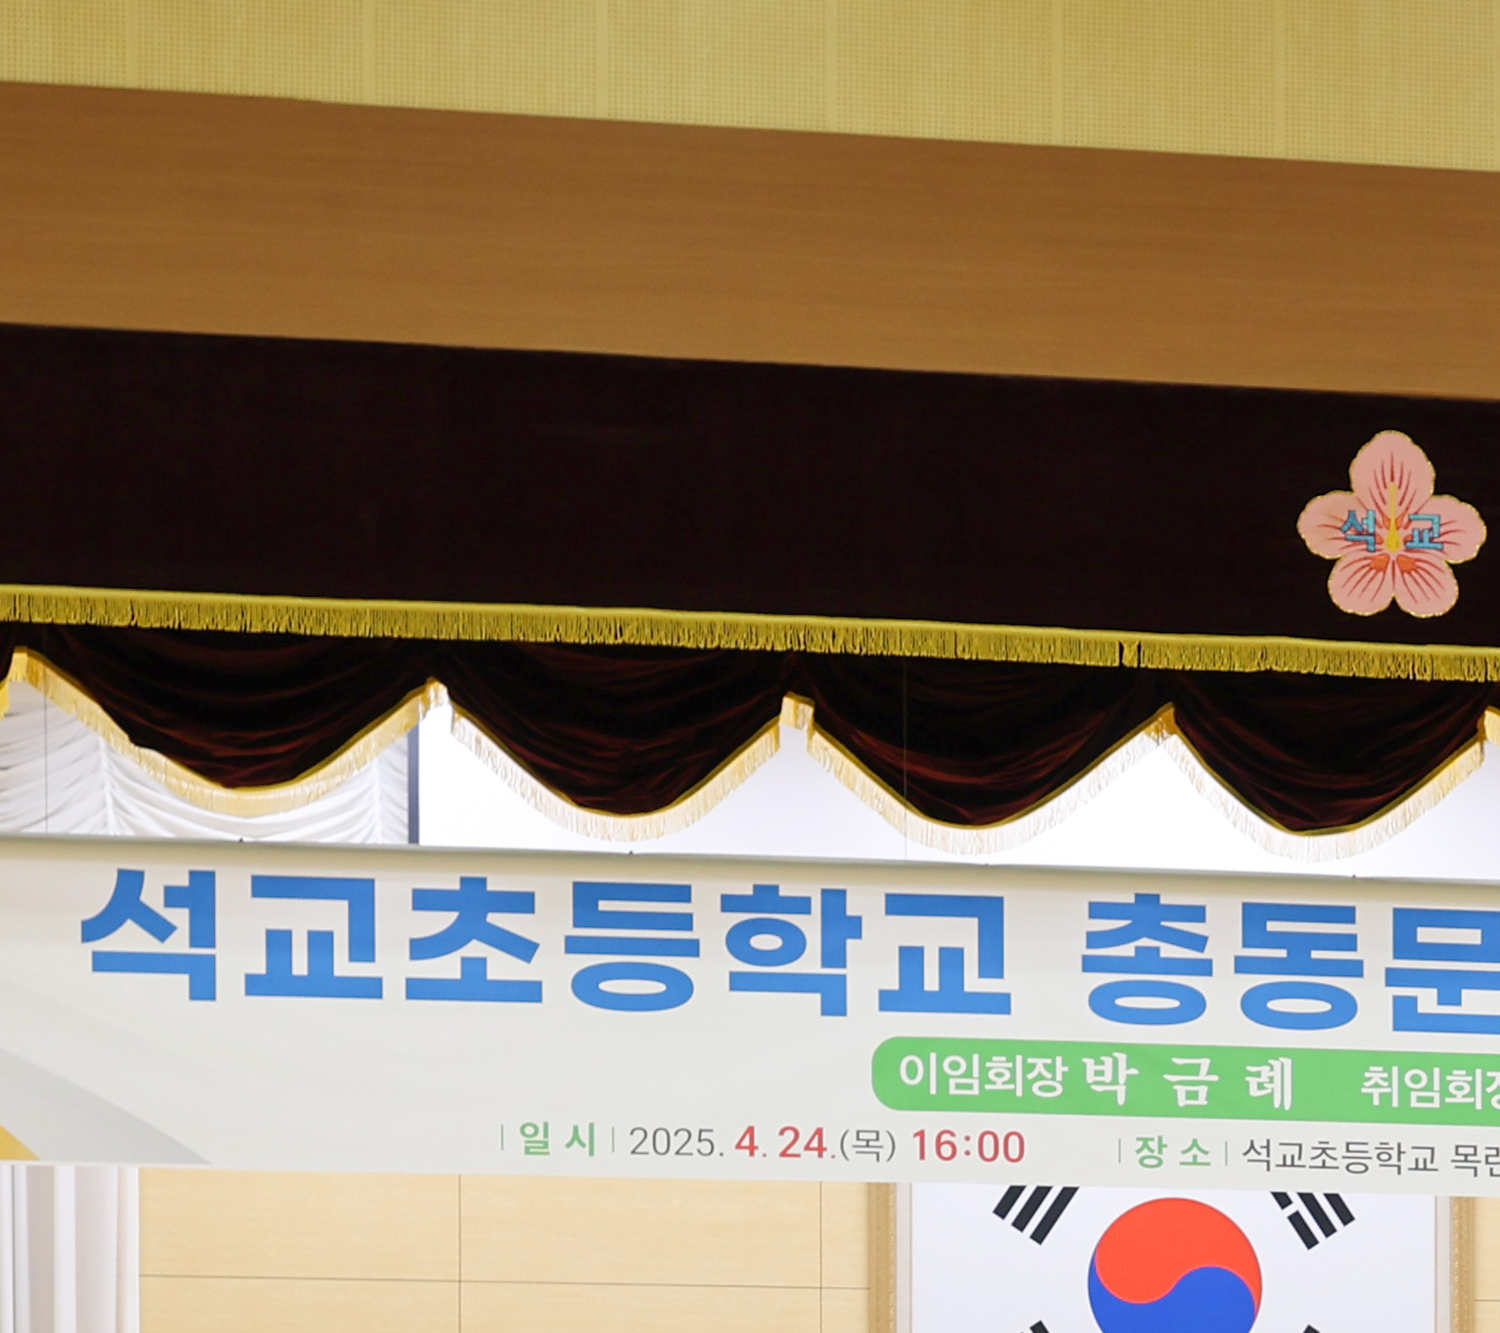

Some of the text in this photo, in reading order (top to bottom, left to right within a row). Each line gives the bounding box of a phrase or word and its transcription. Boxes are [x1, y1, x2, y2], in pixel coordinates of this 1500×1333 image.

[82, 868, 1012, 1017] 석교초등학교
[899, 1052, 1069, 1098] 이임회장
[629, 1126, 726, 1159] 2025.
[911, 1128, 1027, 1164] 16:00
[1242, 1137, 1439, 1176] 석교초등학교
